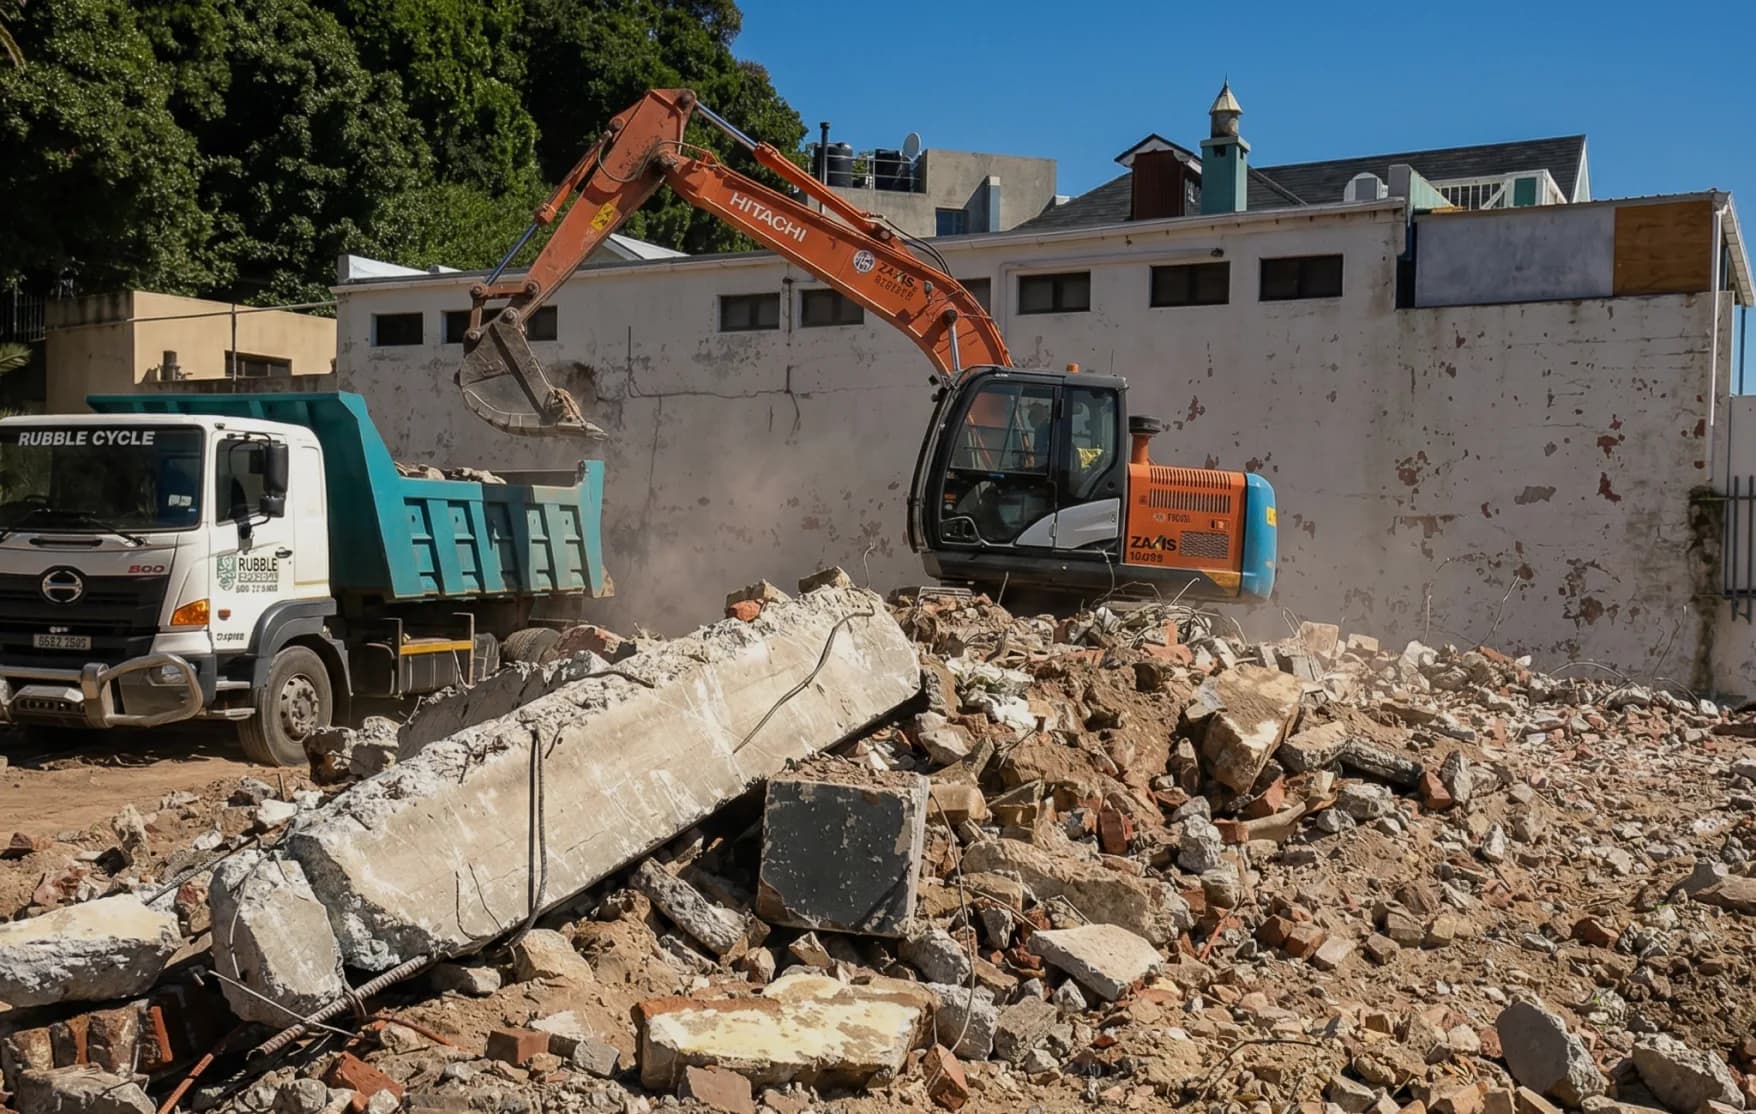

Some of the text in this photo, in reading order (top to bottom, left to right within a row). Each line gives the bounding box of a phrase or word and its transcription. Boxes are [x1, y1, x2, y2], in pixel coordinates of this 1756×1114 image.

[729, 191, 807, 243] HITACHI
[18, 430, 155, 446] RUBBLE CYCLE
[238, 557, 278, 571] RUBBLE
